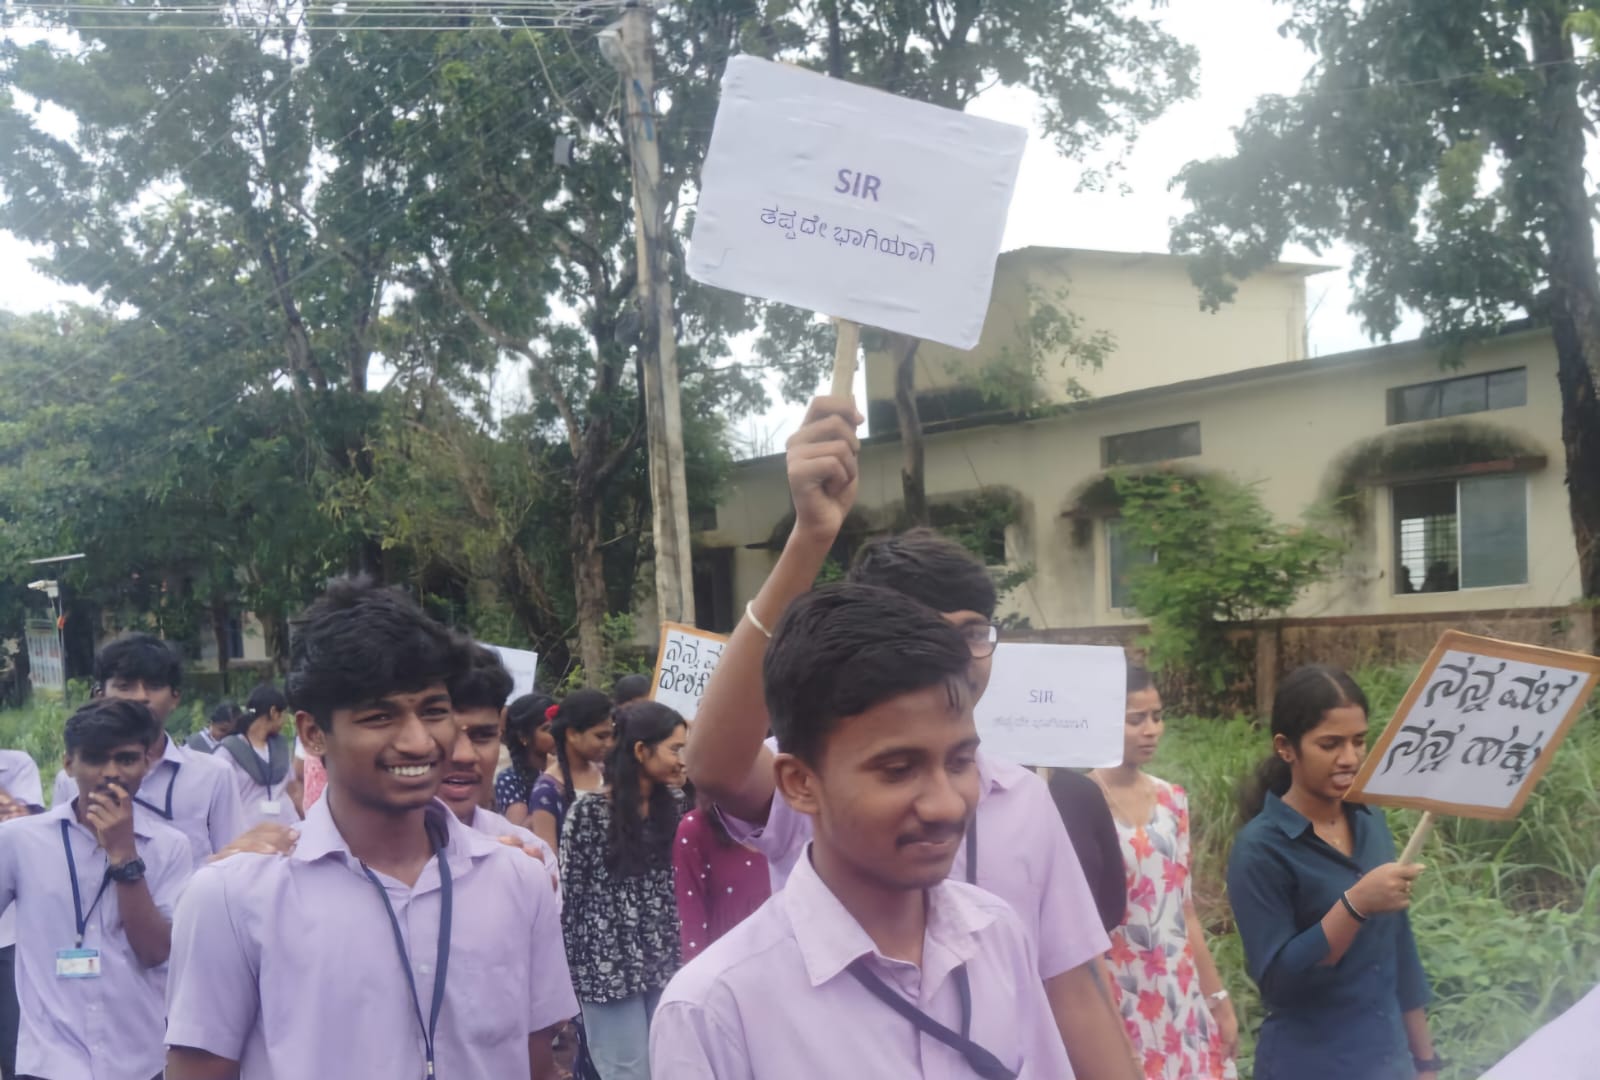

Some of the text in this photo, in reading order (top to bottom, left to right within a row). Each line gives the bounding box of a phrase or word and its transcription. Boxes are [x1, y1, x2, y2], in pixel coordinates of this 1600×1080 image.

[834, 168, 882, 202] SIR
[760, 204, 936, 265] ತಪ್ಪದೇ ಭಾಗಿಯಾಗಿ
[666, 635, 700, 670] ನನ್ನ
[1028, 689, 1055, 704] SIR
[1424, 656, 1579, 715] ನನ್ನ ಮತ
[1381, 719, 1545, 787] ನನ್ನ ಹಕ್ಕು
